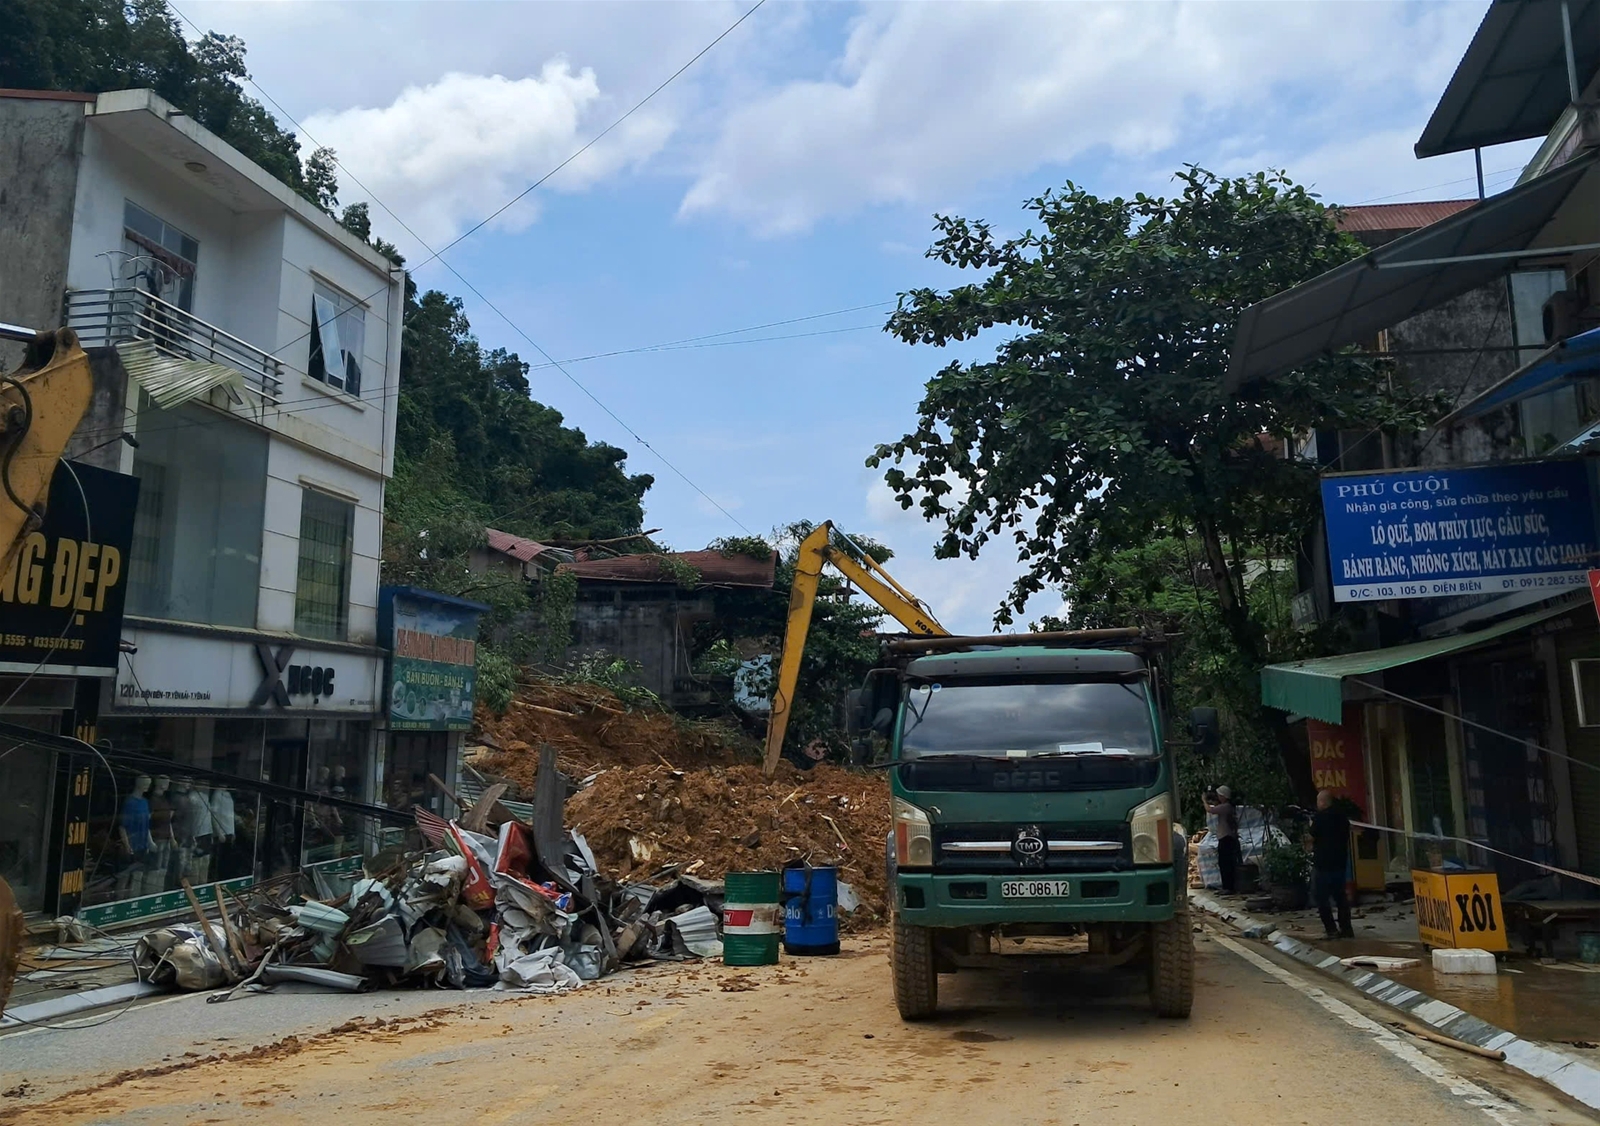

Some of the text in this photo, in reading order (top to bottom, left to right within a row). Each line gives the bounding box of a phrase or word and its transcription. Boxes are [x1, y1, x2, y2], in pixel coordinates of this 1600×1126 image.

[1337, 475, 1450, 498] PHÚ CUỘI
[1346, 501, 1376, 515] Nhận
[1380, 501, 1397, 513] gia
[1492, 492, 1519, 503] theo
[1371, 519, 1385, 545] LÔ
[1342, 552, 1374, 578] BÁNH
[1410, 548, 1450, 574] NHÔNG
[1482, 544, 1507, 570] MÁY
[1508, 546, 1533, 568] XAY
[1535, 540, 1559, 566] CÁC
[51, 537, 121, 626] ĐẸP
[1400, 585, 1417, 595] 105
[1433, 581, 1457, 595] ĐIỆN
[1459, 580, 1482, 592] BIÊN
[1520, 577, 1545, 588] 0912
[1548, 575, 1566, 586] 282
[1568, 574, 1587, 585] 555
[120, 684, 135, 698] 120
[1018, 842, 1040, 850] TMT
[1455, 883, 1497, 933] XÔI
